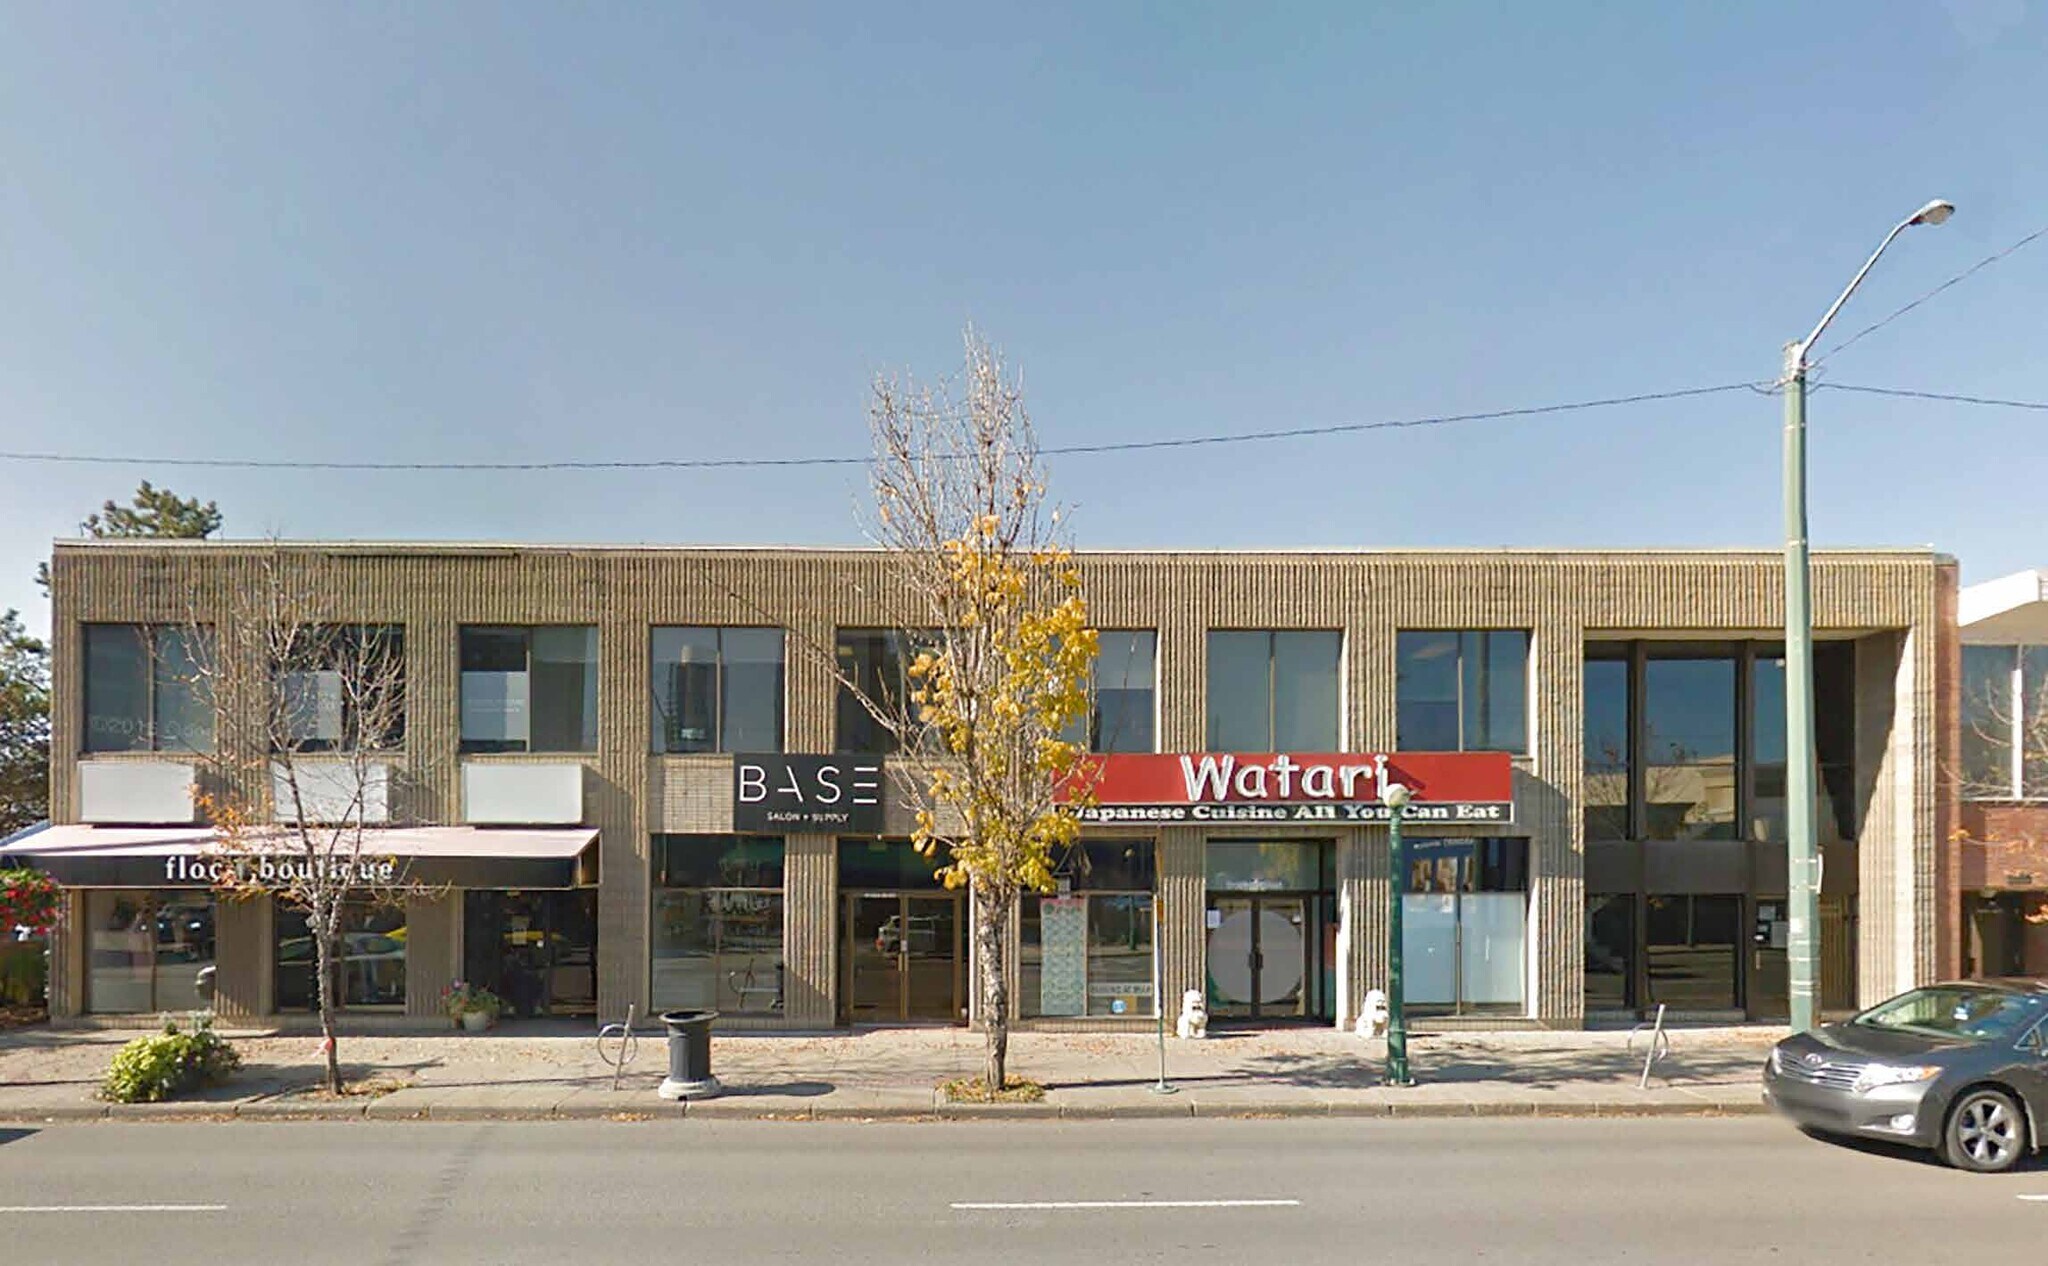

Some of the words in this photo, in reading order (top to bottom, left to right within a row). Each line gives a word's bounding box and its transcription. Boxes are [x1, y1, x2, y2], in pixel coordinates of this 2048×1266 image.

[739, 765, 878, 804] BASE
[1180, 754, 1388, 801] Watari
[766, 811, 800, 821] SALON
[812, 813, 849, 823] SUPPLY
[1192, 806, 1287, 819] Cuisine
[1293, 806, 1335, 819] All
[1343, 805, 1390, 819] You
[1401, 805, 1449, 819] Can
[1456, 805, 1500, 818] Eat
